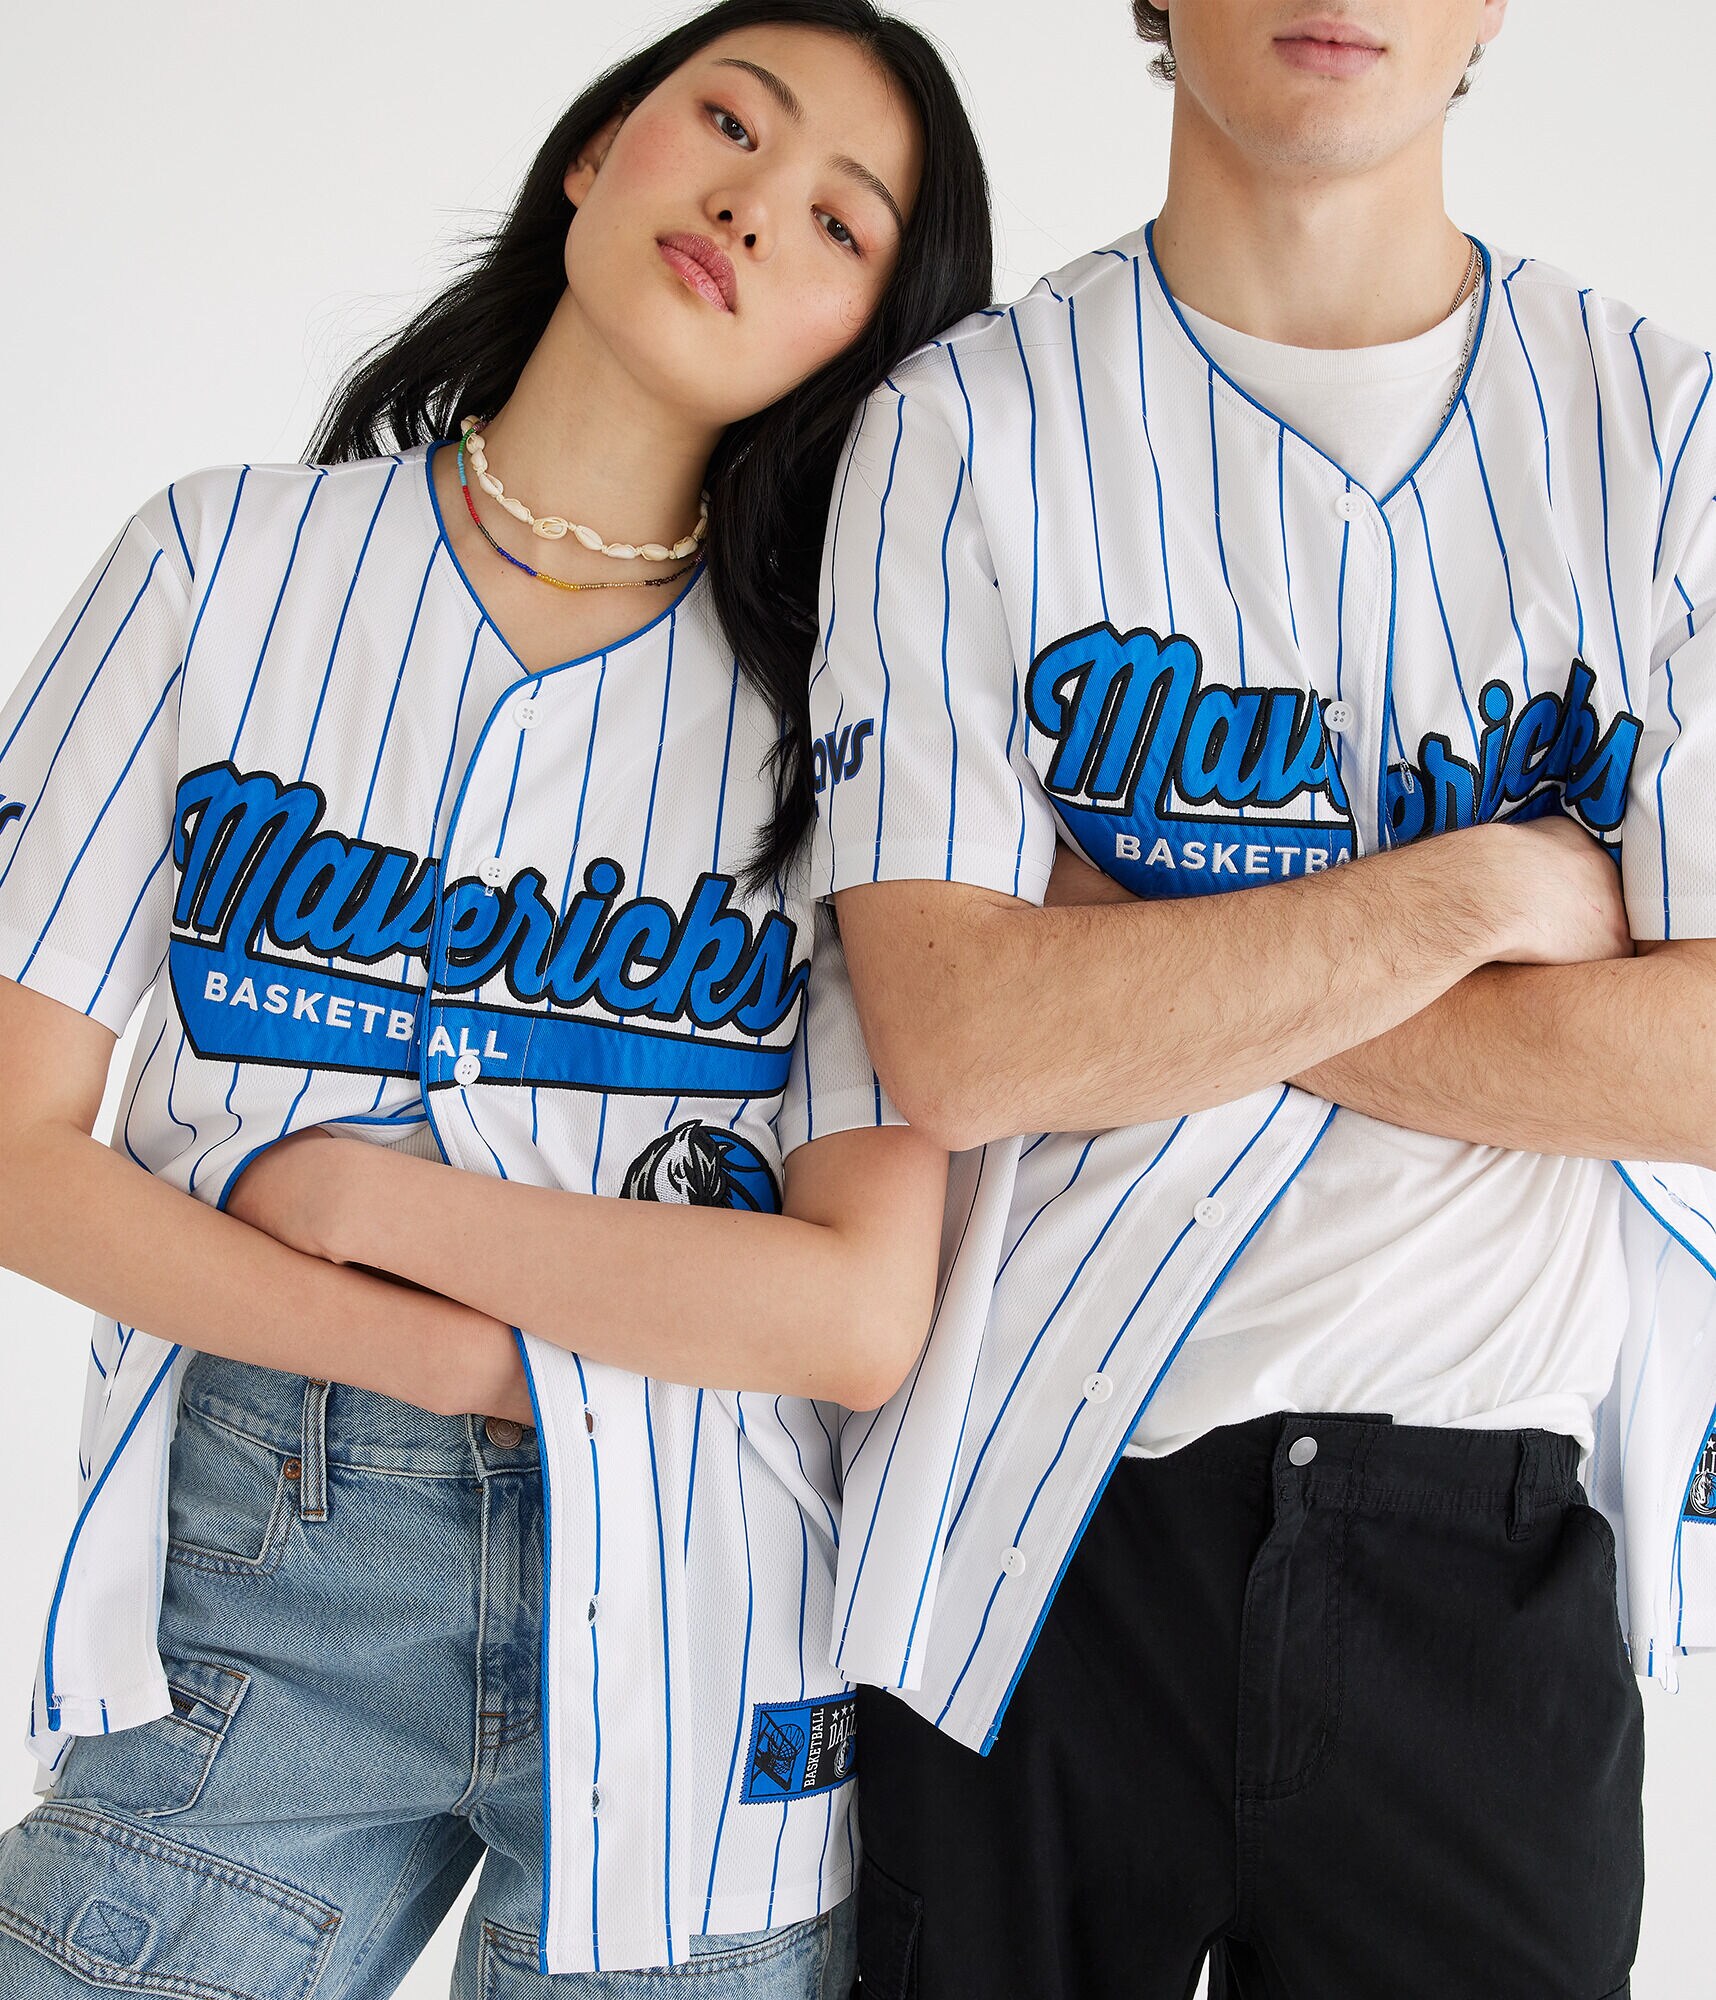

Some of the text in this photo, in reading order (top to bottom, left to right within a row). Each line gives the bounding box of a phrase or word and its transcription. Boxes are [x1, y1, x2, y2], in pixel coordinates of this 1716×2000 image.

[813, 718, 875, 794] avs
[1115, 832, 1351, 877] BASKETBA
[172, 760, 812, 1037] Mavericks
[203, 970, 509, 1061] BASKETBALL
[803, 1707, 825, 1788] BASKETBALL
[827, 1712, 858, 1751] DALL
